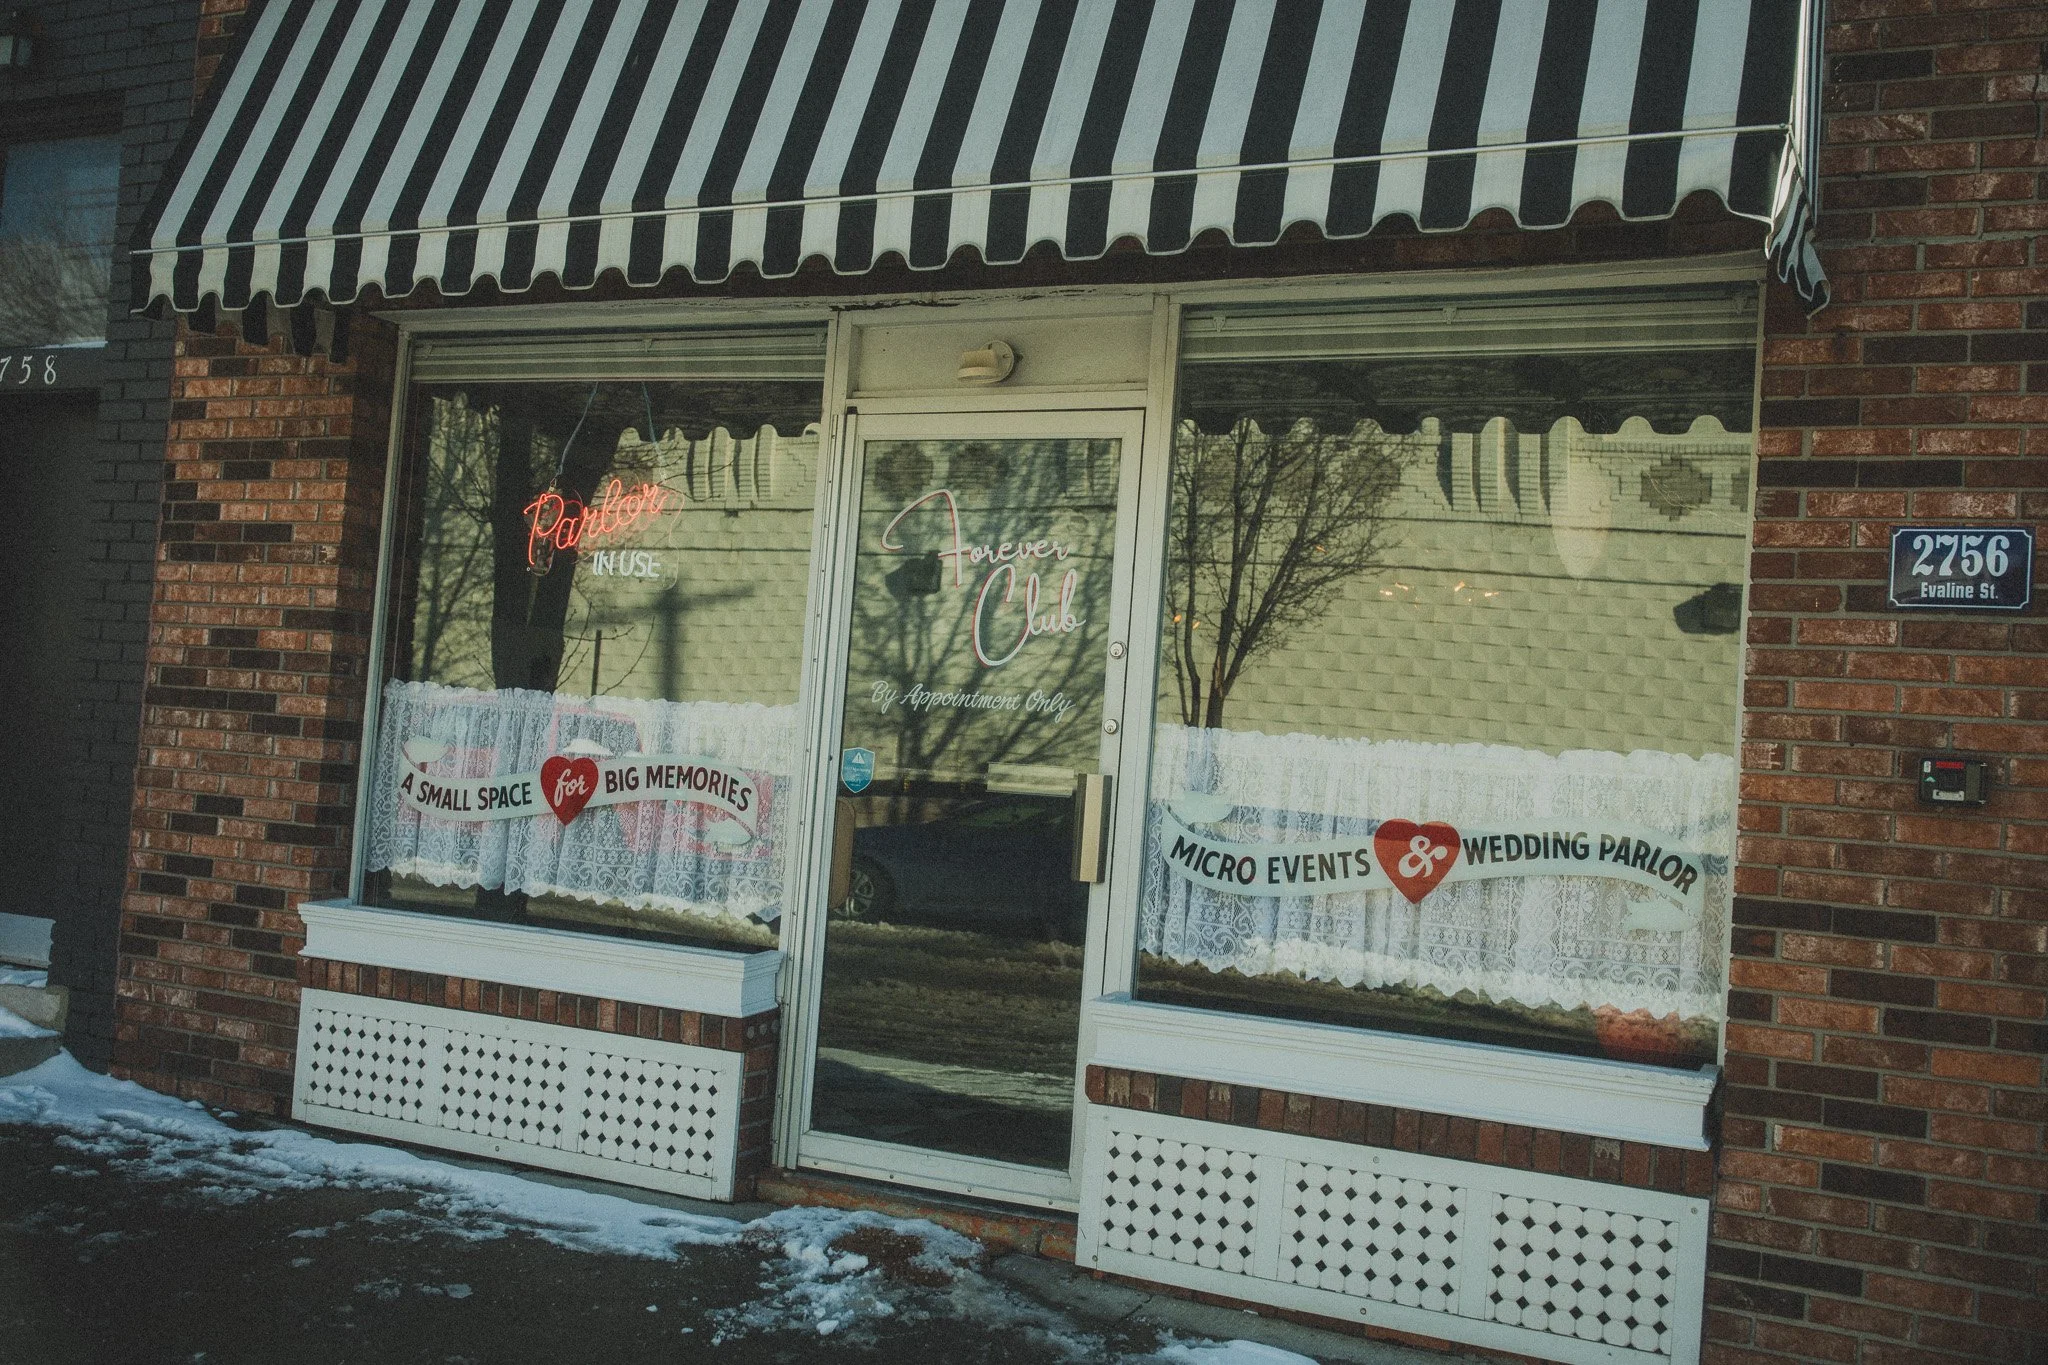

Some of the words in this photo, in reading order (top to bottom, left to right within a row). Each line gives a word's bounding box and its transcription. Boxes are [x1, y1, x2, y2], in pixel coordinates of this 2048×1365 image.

[523, 479, 668, 565] Parlor
[881, 489, 1070, 588] Forever
[592, 551, 616, 576] IN
[619, 551, 661, 578] USE
[1912, 534, 2010, 577] 2756
[1920, 582, 1974, 599] Evaline
[1979, 583, 1999, 599] St.
[972, 563, 1087, 668] Club
[871, 681, 896, 714] By
[899, 683, 1021, 713] Appointment
[1025, 689, 1077, 724] Only
[400, 772, 414, 795] A
[416, 780, 472, 812] SMALL
[477, 781, 533, 810] SPACE
[554, 768, 590, 808] for
[605, 766, 640, 794] BIG
[645, 764, 752, 812] MEMORIES
[1169, 834, 1257, 886] MICRO
[1267, 848, 1371, 885] EVENTS
[1398, 835, 1448, 879] &
[1462, 831, 1590, 866] WEDDING
[1598, 833, 1698, 896] PARLOR
